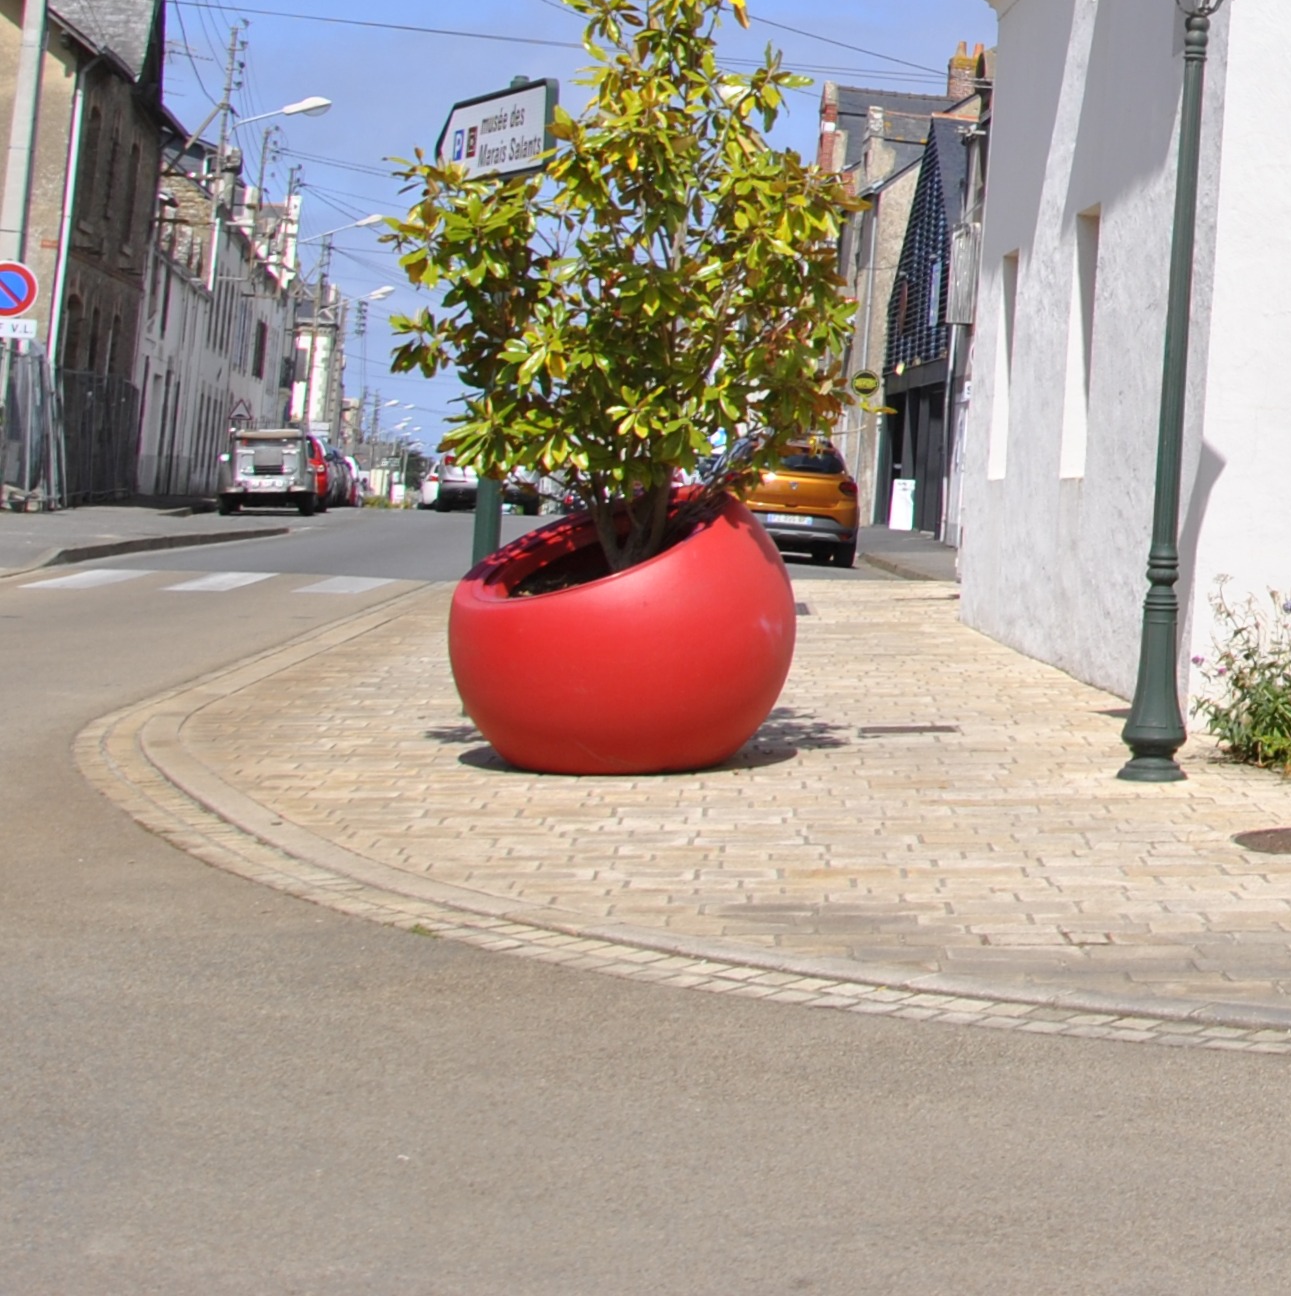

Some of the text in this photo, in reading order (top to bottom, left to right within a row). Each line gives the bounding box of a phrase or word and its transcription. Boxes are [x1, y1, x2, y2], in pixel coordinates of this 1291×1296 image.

[481, 104, 525, 134] musée des
[479, 135, 541, 167] Marais Salants
